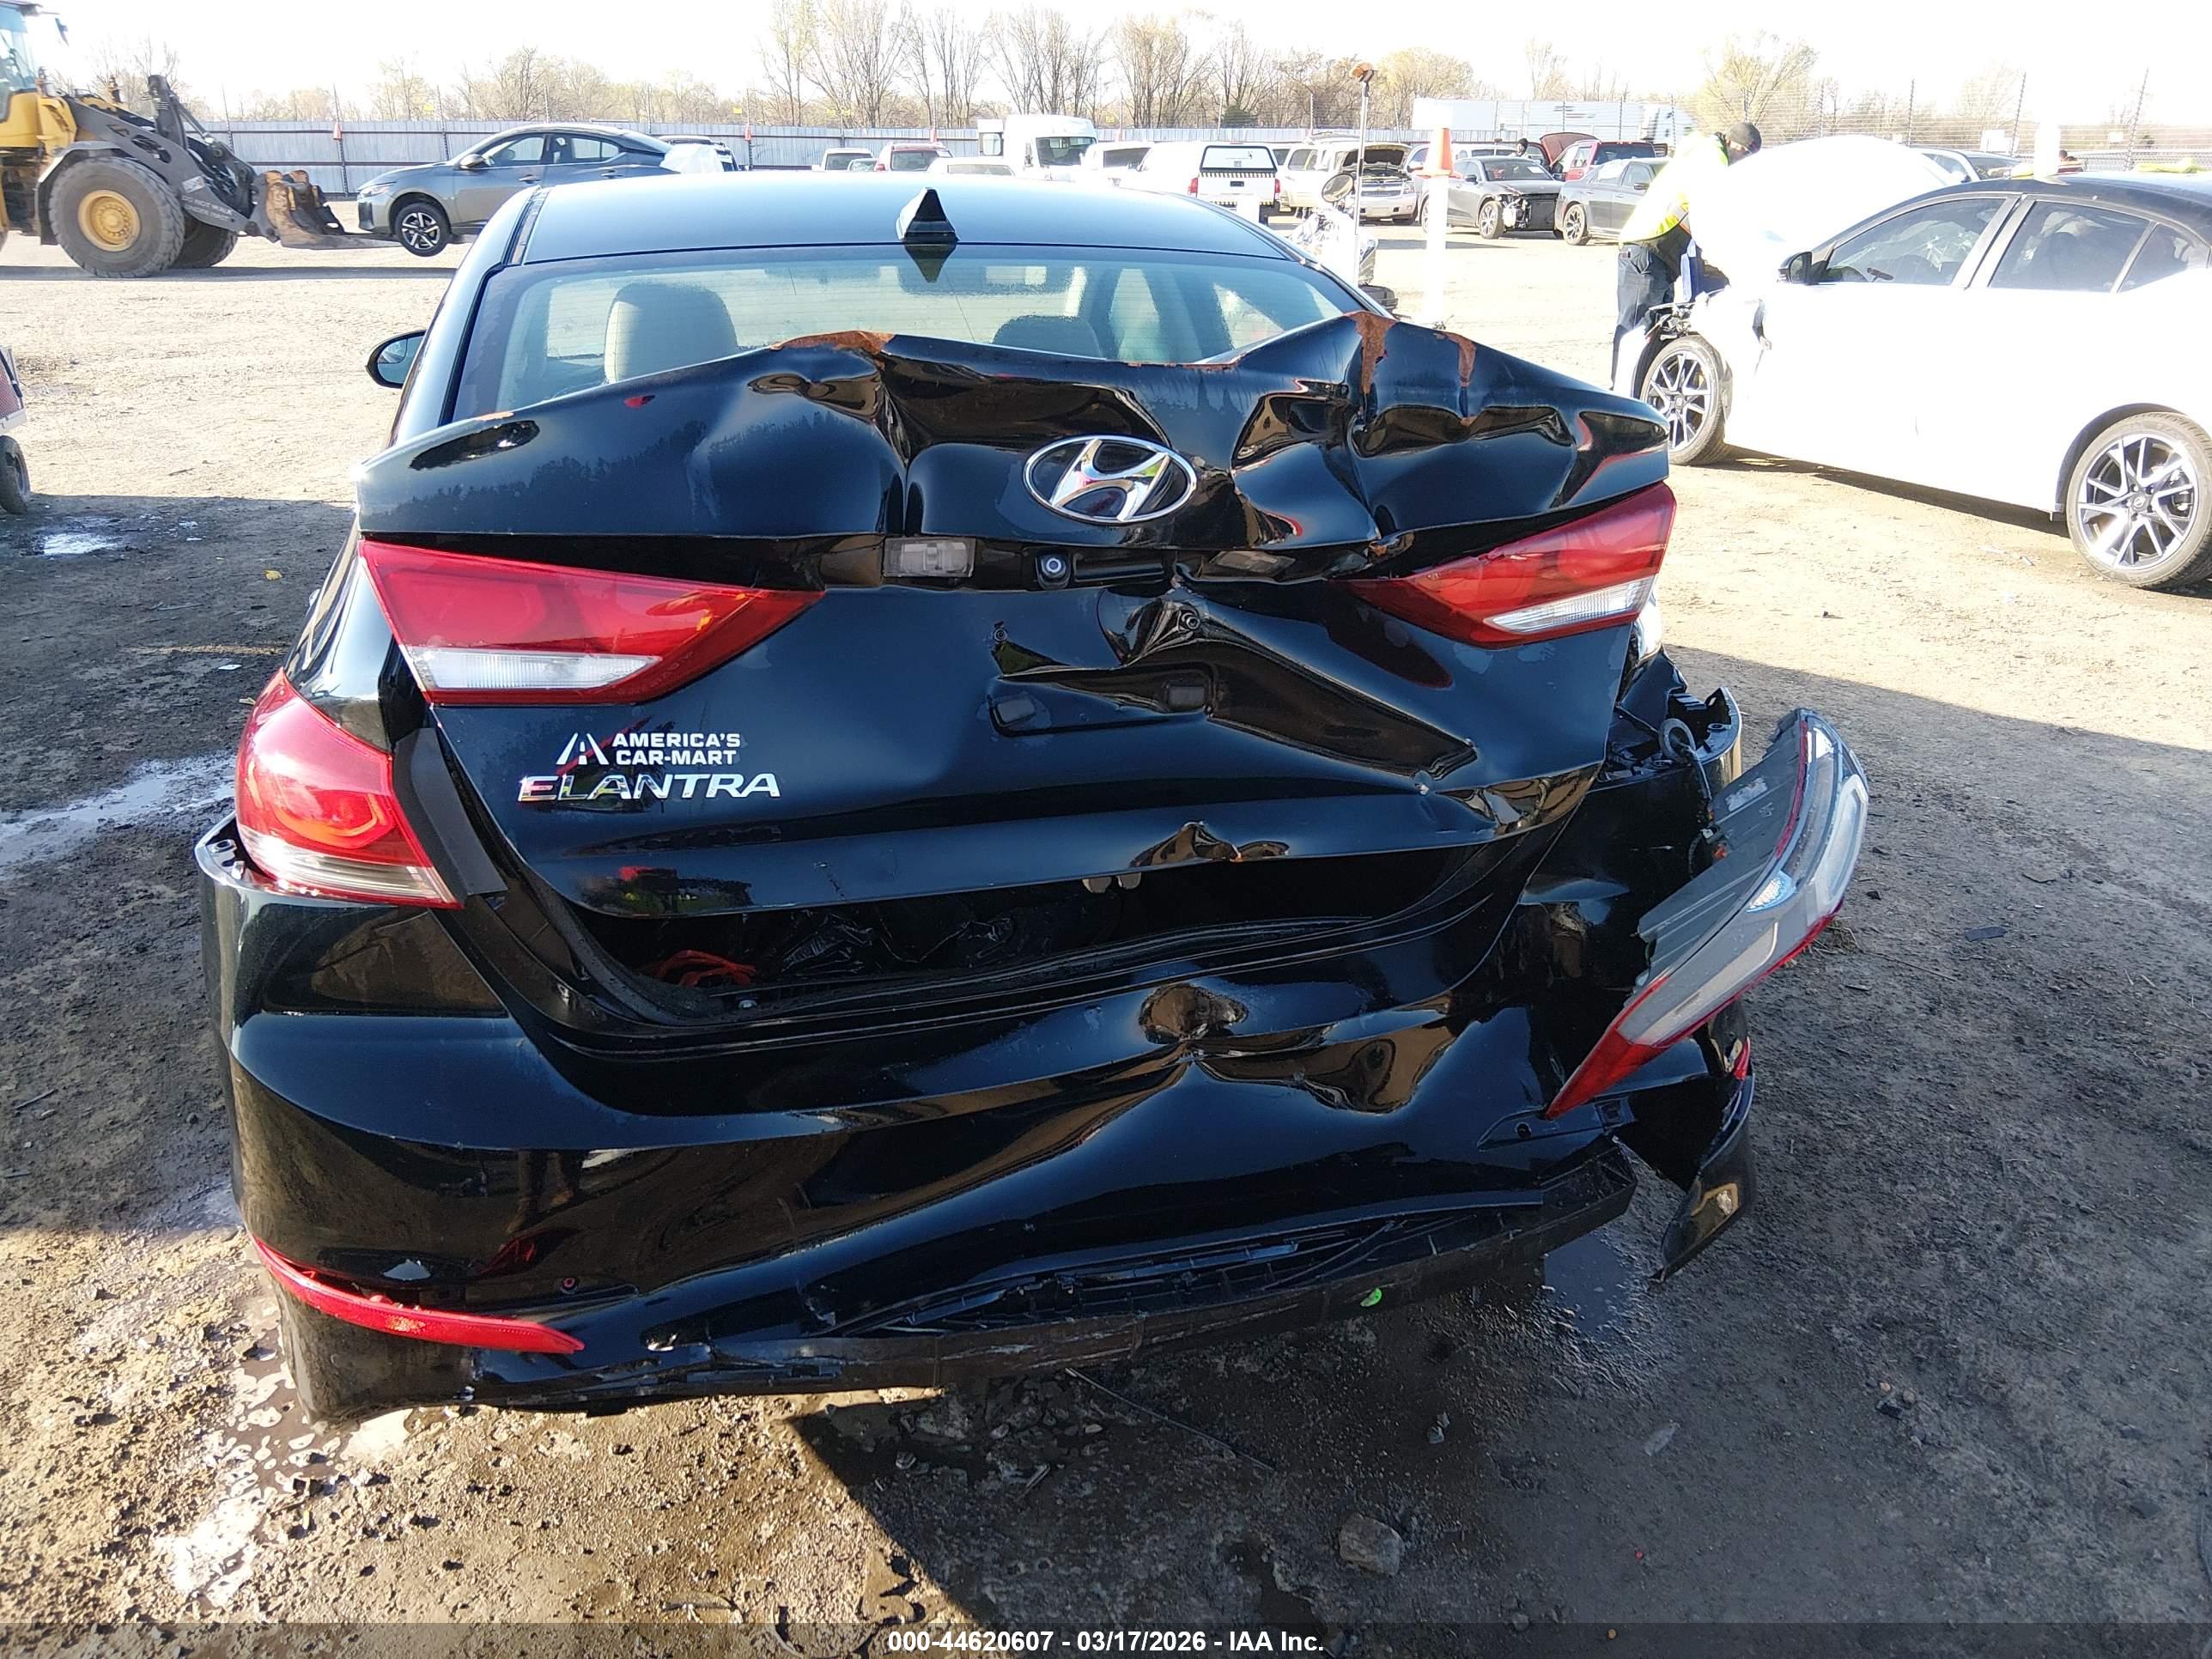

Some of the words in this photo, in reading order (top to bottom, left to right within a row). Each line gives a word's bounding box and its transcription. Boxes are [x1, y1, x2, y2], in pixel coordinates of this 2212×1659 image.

[612, 732, 741, 749] AMERICA'S
[616, 749, 737, 766] CAR-MART
[517, 773, 781, 802] ELANTRA
